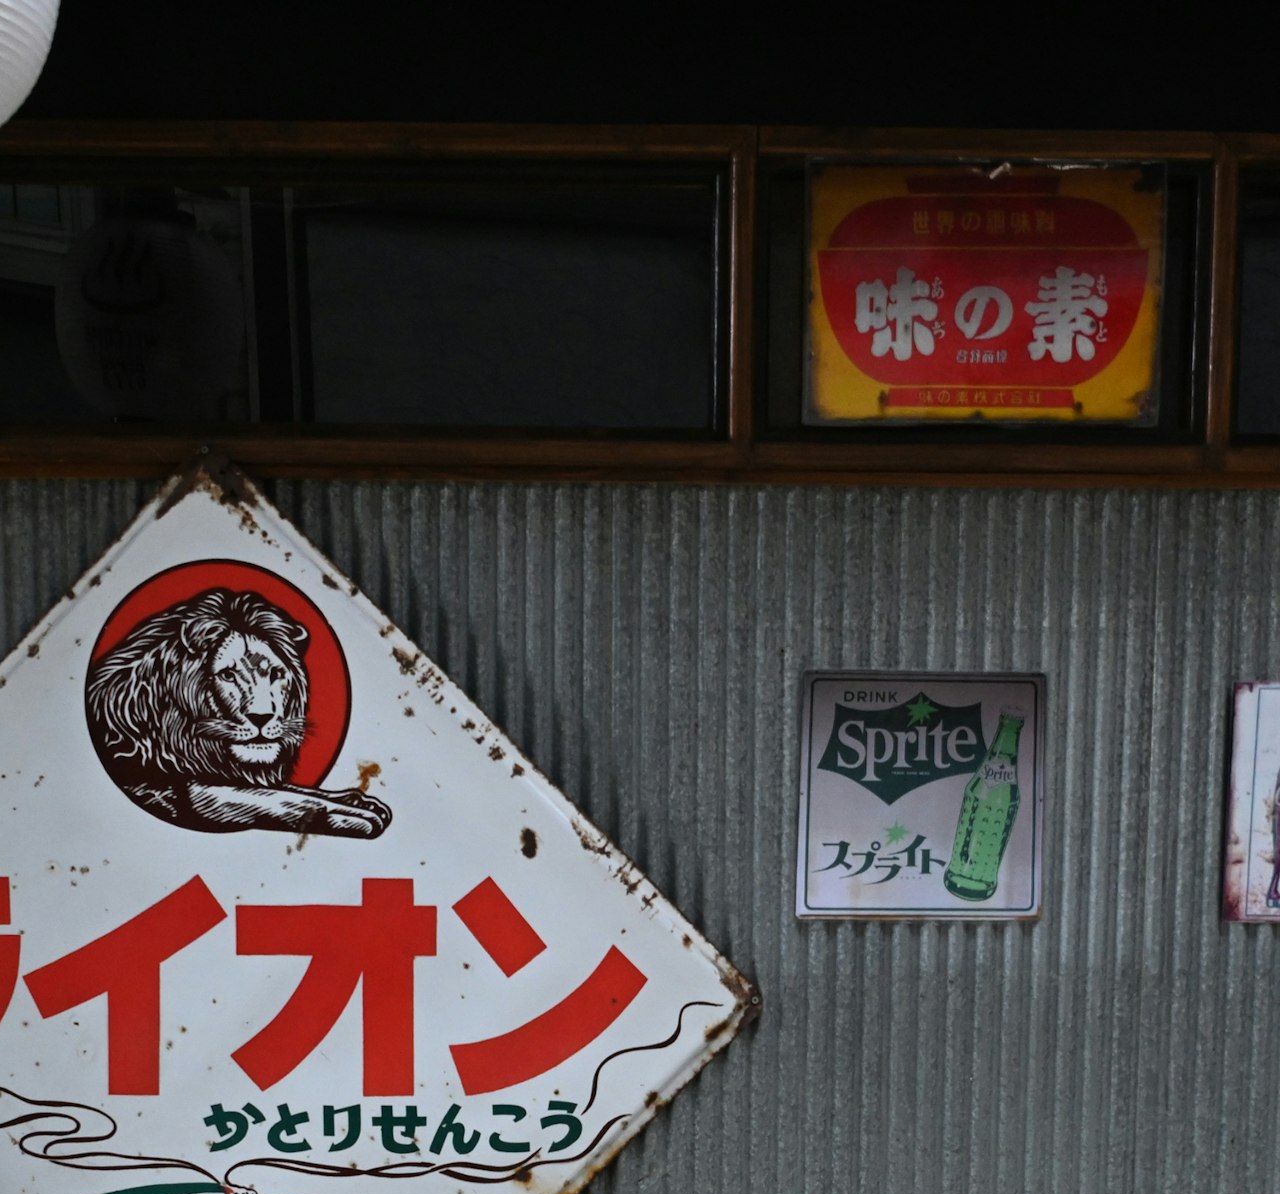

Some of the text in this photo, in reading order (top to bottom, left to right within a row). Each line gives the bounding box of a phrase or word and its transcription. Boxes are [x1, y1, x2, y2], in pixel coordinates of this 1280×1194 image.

[855, 266, 1108, 363] 味の素
[844, 691, 898, 703] DRINK
[837, 719, 977, 781] Sprite
[983, 764, 1014, 781] Sprite
[812, 834, 946, 885] スプライト
[204, 1101, 586, 1154] かとりせんこう
